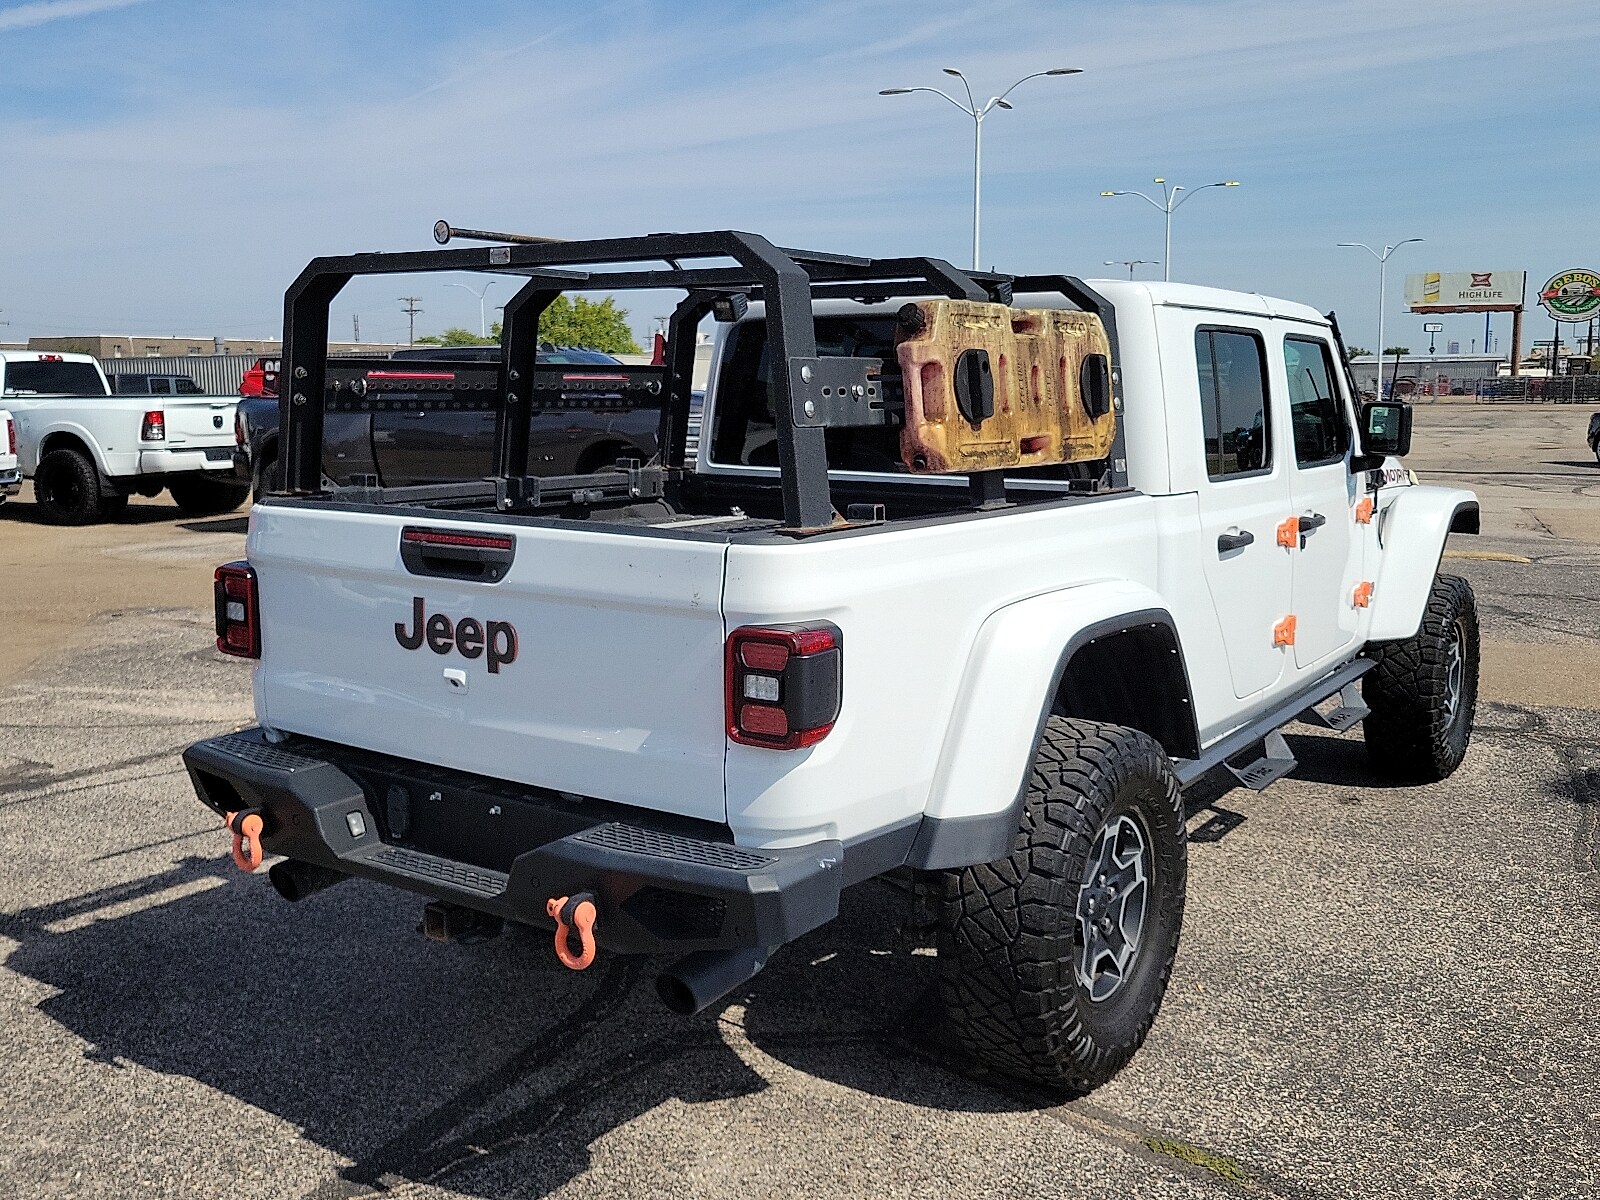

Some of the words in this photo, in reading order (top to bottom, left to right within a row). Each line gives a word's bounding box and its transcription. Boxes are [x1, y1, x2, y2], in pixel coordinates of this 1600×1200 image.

[1552, 273, 1600, 289] GEBO'S
[1458, 291, 1482, 299] HIGH
[1483, 290, 1503, 298] LIFE
[394, 596, 519, 674] Jeep
